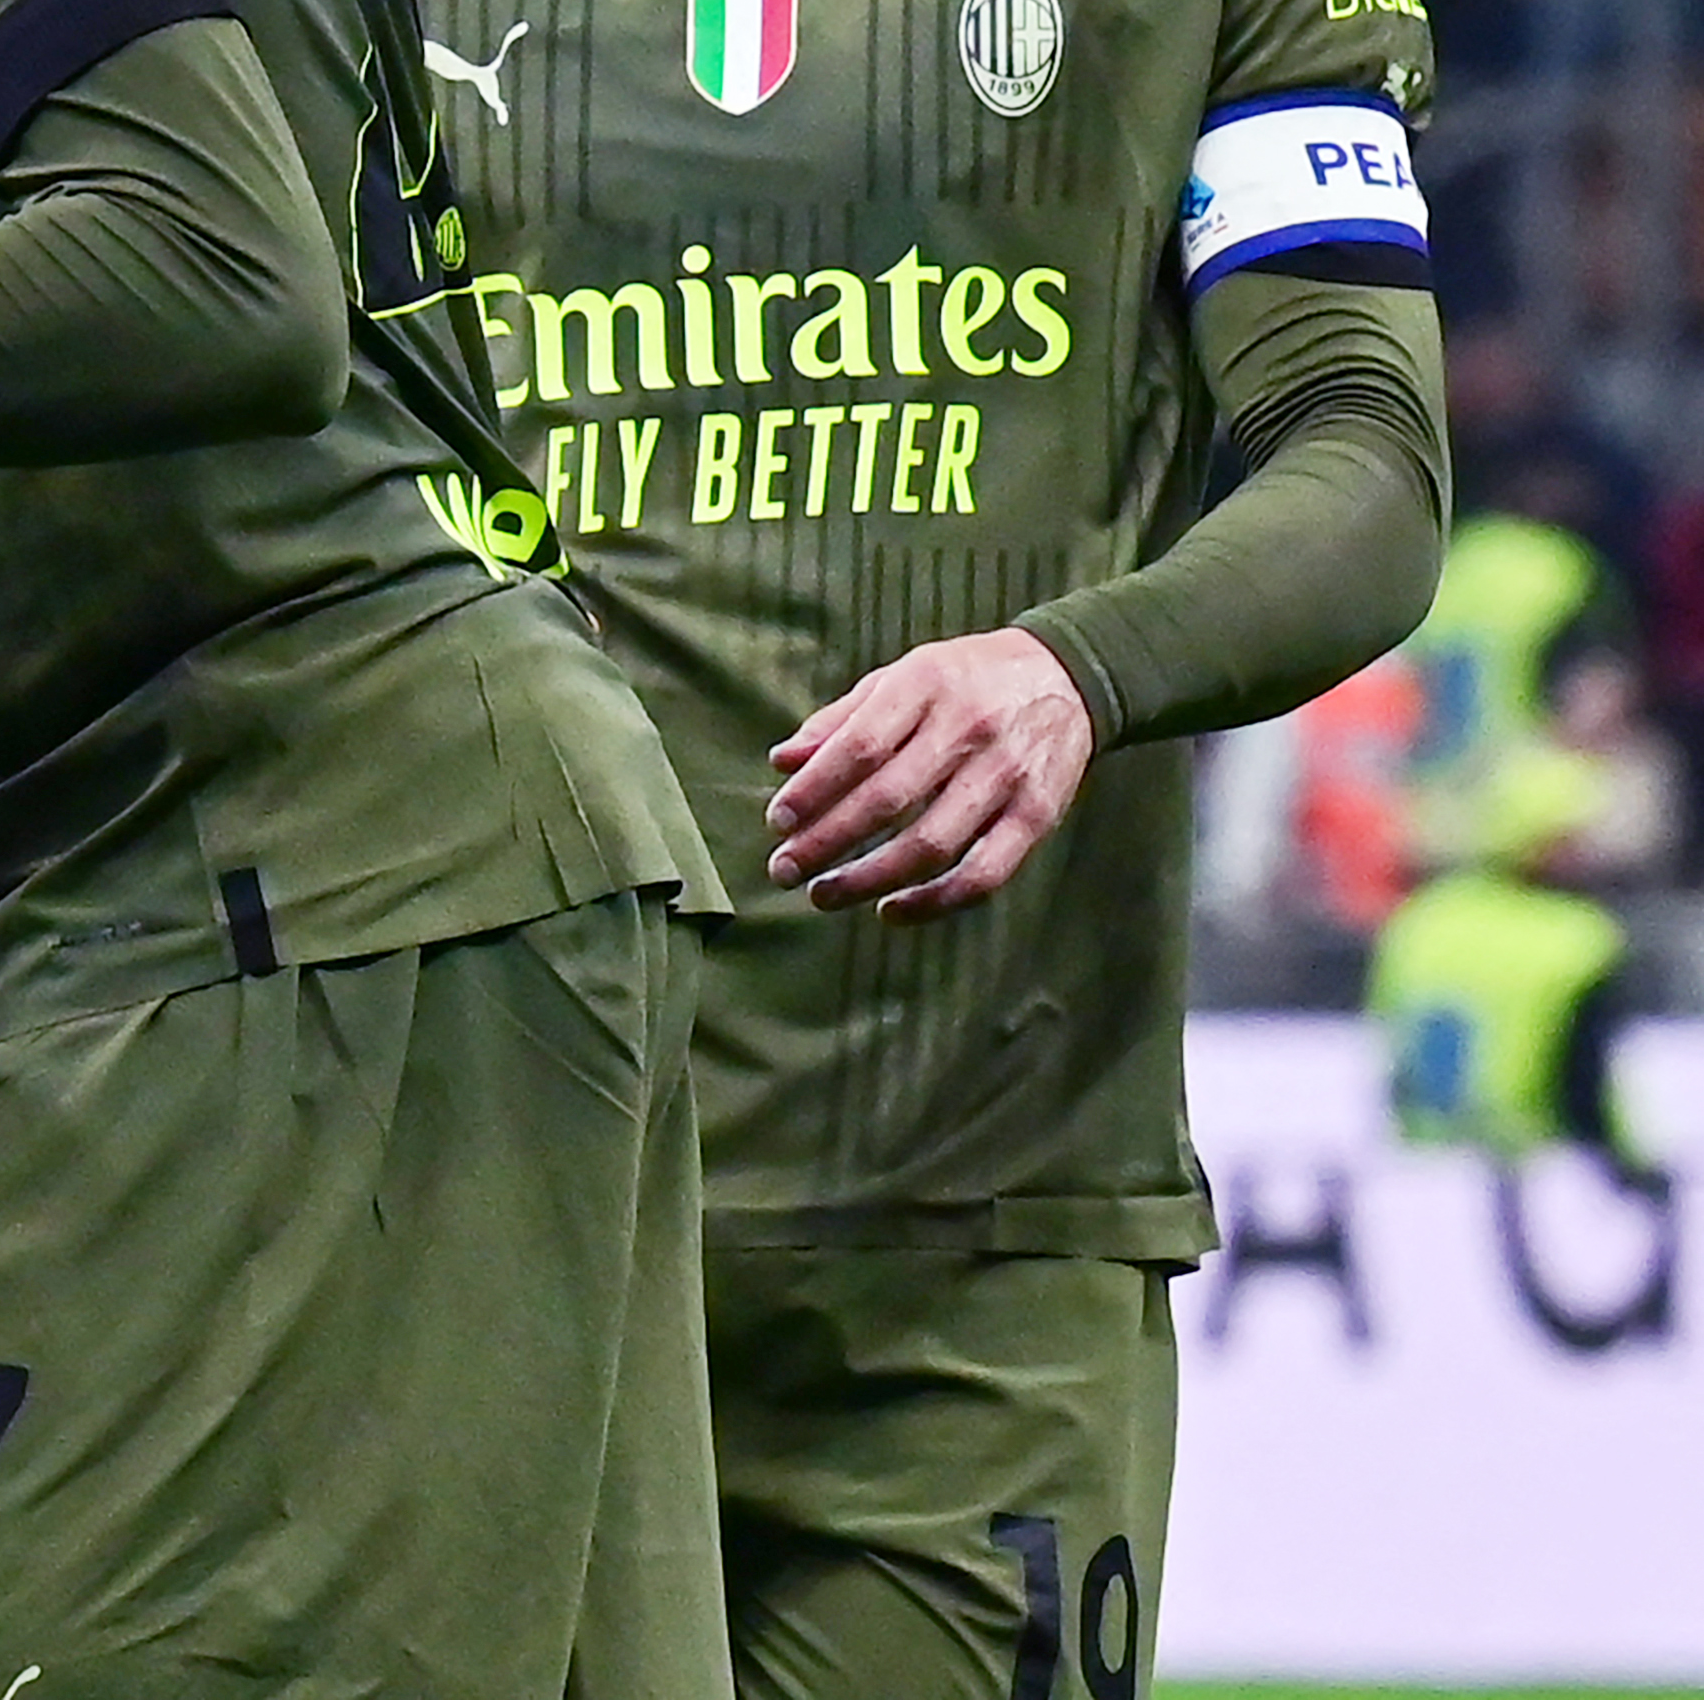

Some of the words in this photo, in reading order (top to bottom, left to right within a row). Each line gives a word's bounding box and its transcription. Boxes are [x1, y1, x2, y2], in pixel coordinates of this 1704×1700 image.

[989, 79, 1036, 97] 1899
[472, 244, 1071, 408] Emirates
[545, 417, 662, 535] FLY
[691, 402, 982, 525] BETTER
